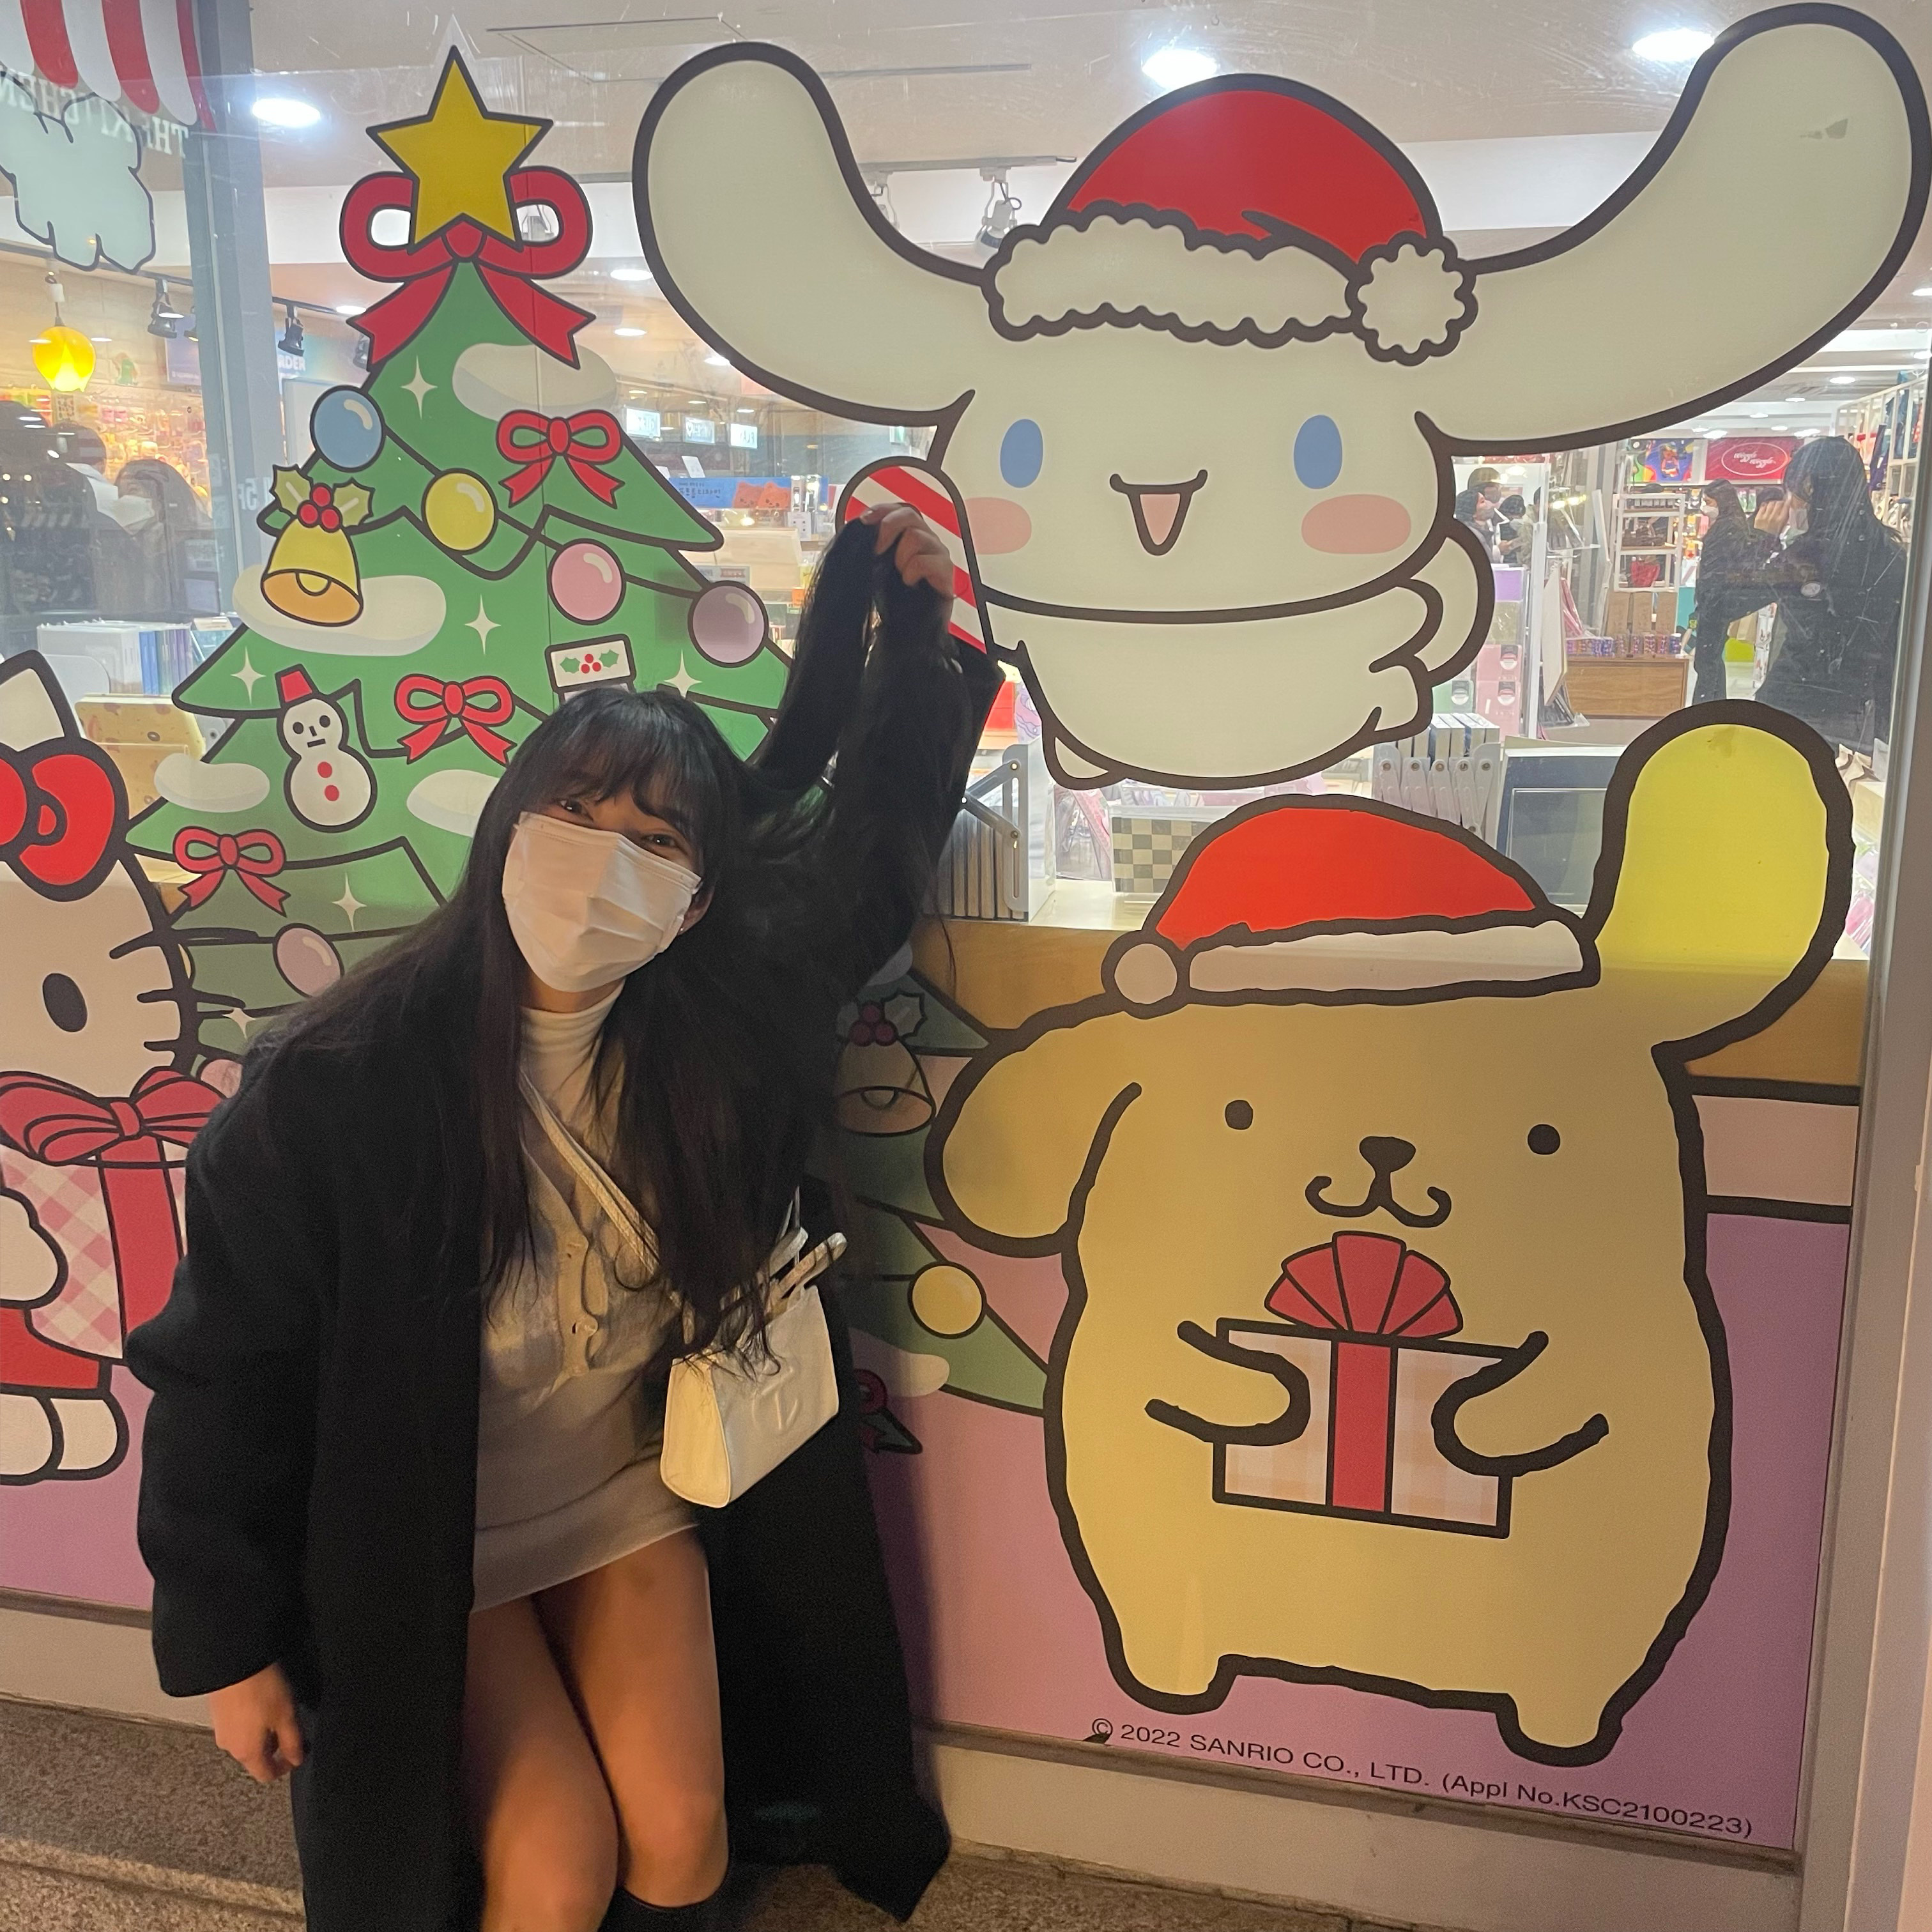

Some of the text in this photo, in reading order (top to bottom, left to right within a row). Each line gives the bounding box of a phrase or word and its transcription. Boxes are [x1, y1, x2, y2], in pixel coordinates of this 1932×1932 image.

[1121, 1724, 1181, 1747] 2022
[1190, 1734, 1294, 1764] SANRIO
[1303, 1752, 1360, 1777] CO.,
[1370, 1762, 1430, 1786] LTD.
[1443, 1773, 1508, 1799] (Appl
[1517, 1784, 1752, 1839] No.KSC2100223)
